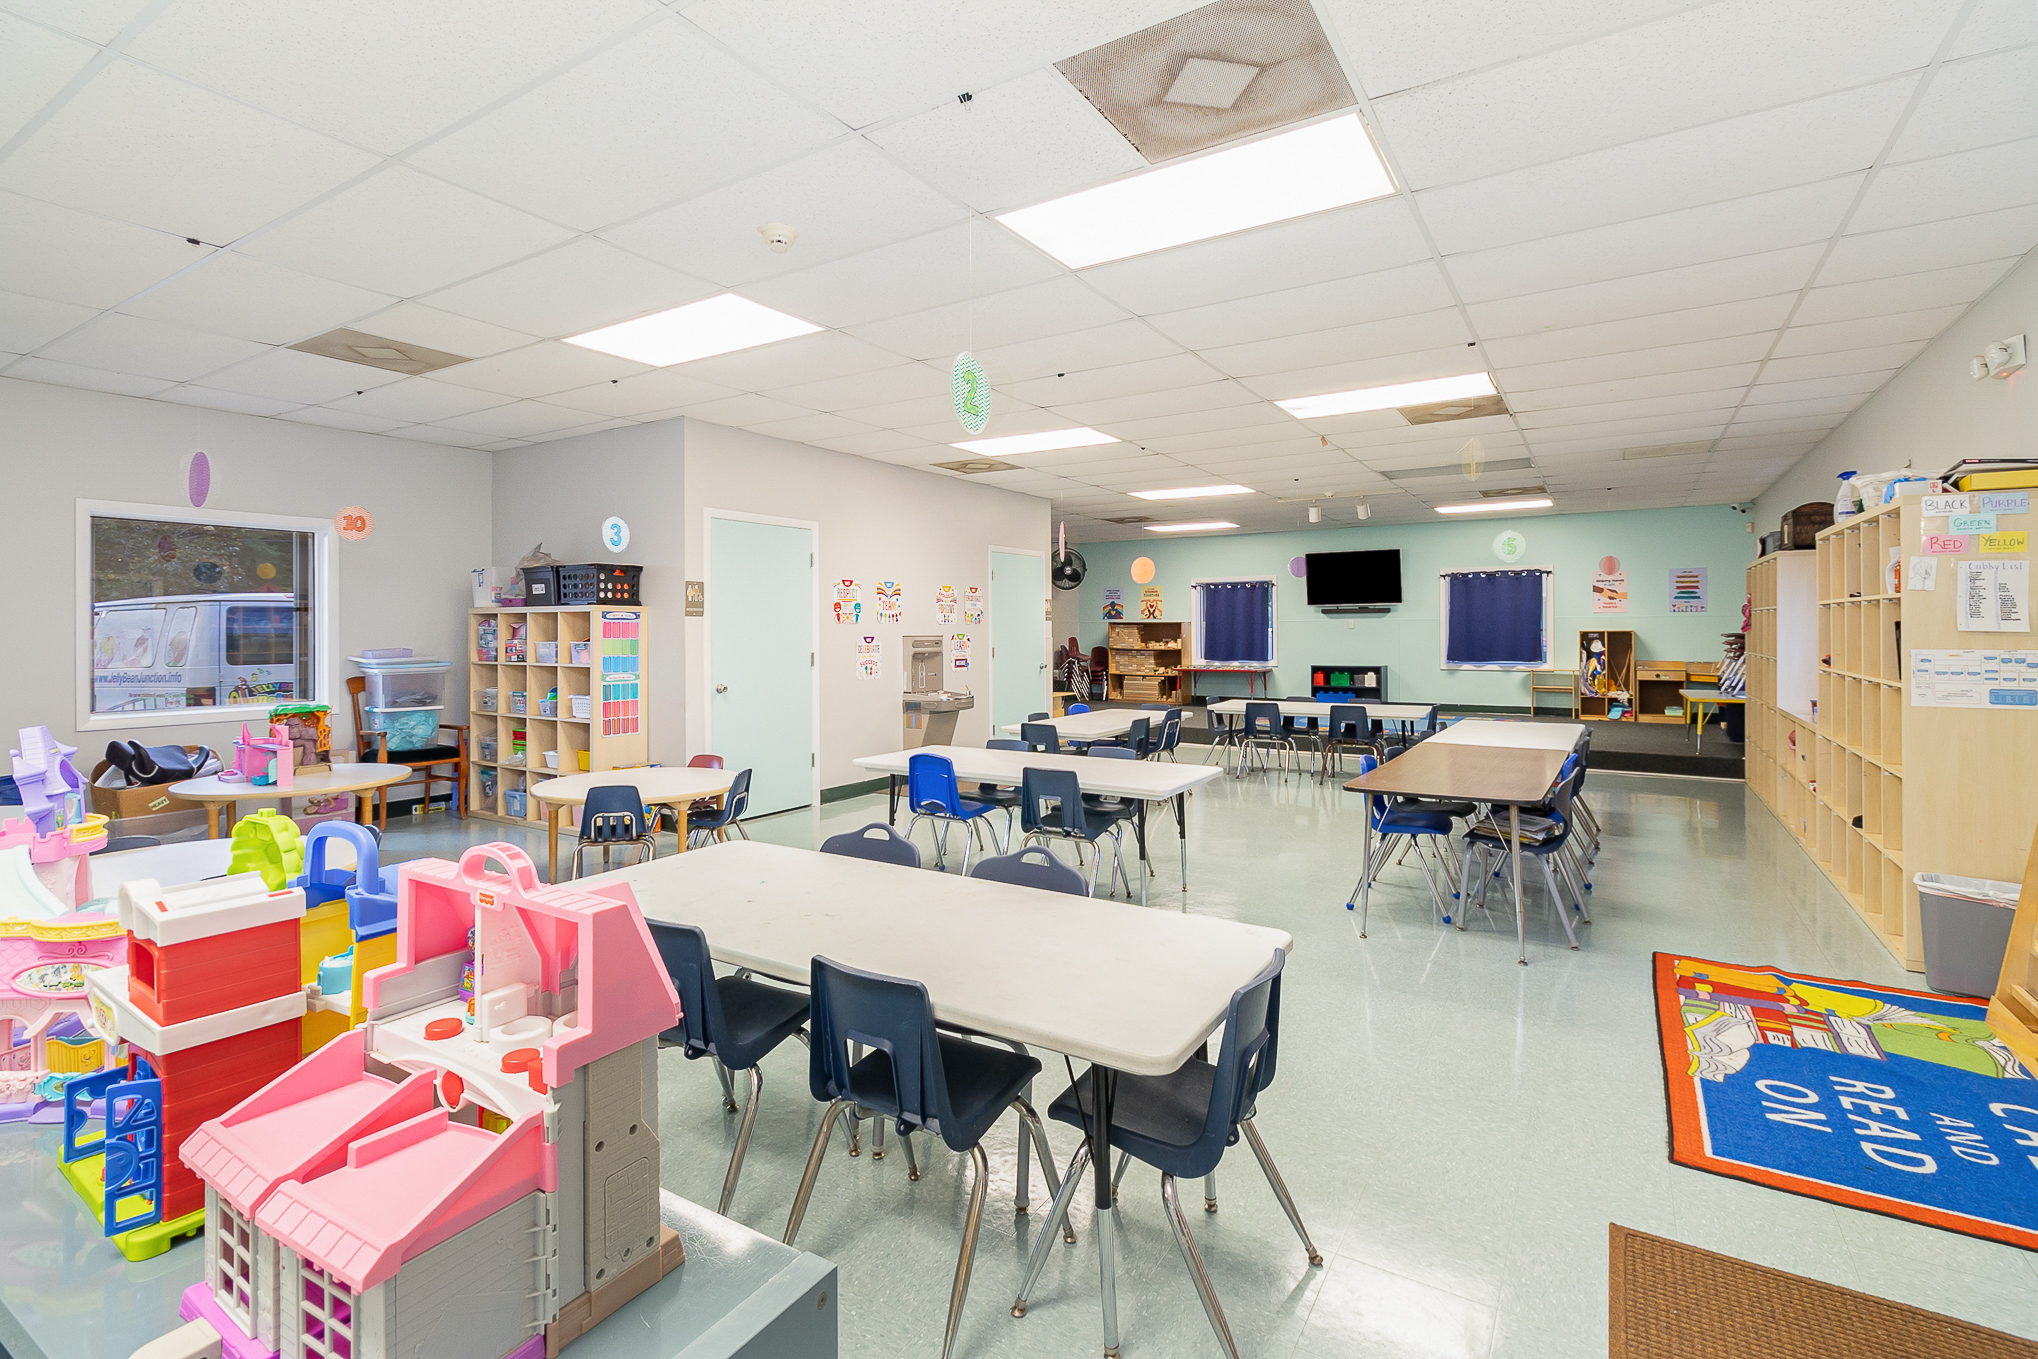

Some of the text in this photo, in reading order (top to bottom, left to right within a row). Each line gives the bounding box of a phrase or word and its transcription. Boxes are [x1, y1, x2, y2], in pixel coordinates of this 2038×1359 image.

[963, 369, 978, 416] 2
[1924, 499, 1968, 511] BLACK
[1982, 496, 2028, 509] PURPLE
[342, 514, 366, 532] 10
[1953, 517, 1991, 528] GREEN
[609, 523, 623, 547] 3
[1982, 535, 2025, 547] YELLOW
[1930, 536, 1963, 550] RED
[1968, 562, 2023, 572] Cubby List
[837, 588, 859, 599] RESPECT
[881, 600, 897, 611] TEAM
[1754, 1078, 1833, 1133] ON
[1828, 1075, 1938, 1175] READ
[1929, 1111, 2000, 1166] AND
